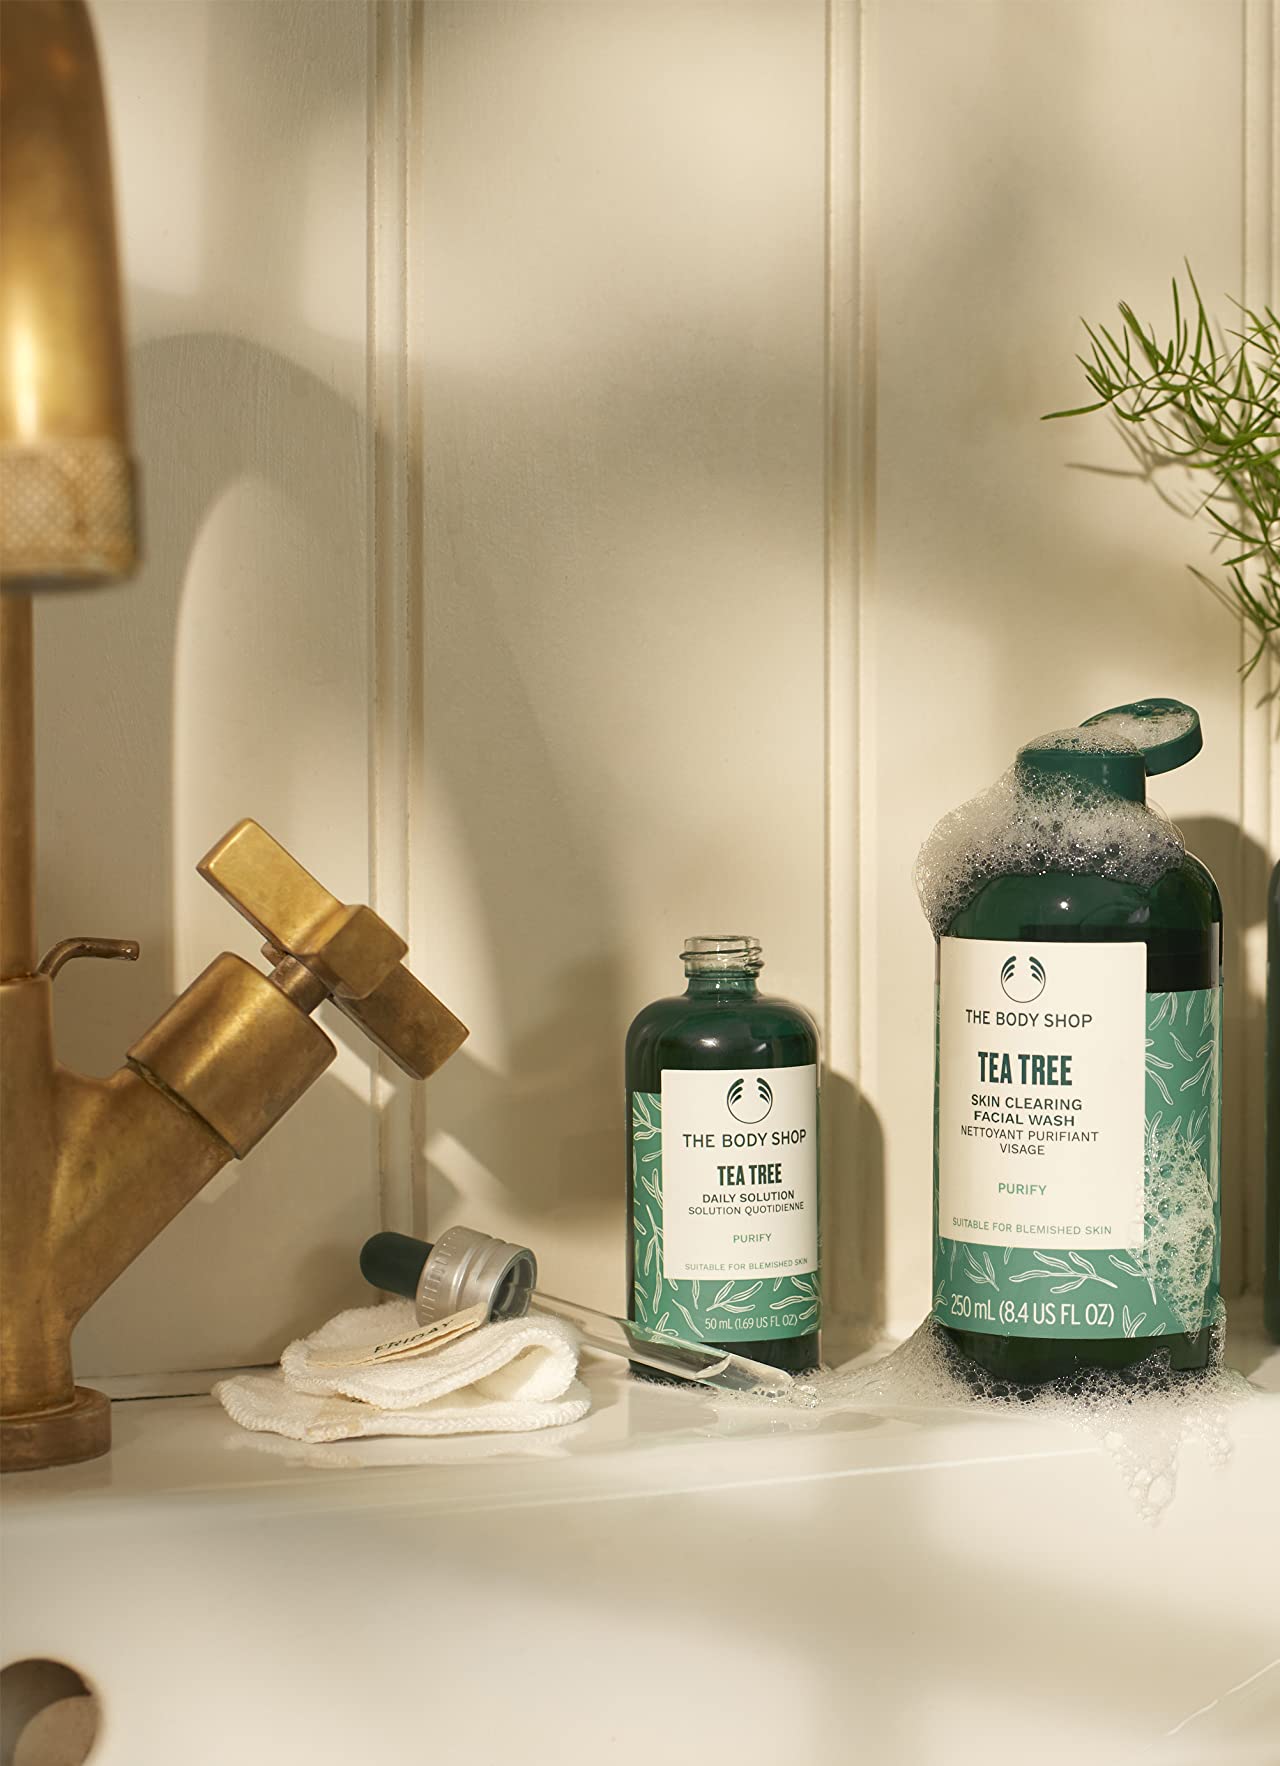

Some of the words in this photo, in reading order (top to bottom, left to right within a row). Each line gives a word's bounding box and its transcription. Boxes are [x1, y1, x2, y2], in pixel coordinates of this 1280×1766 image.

[966, 1010, 990, 1025] THE
[996, 1011, 1039, 1027] BODY
[1044, 1014, 1092, 1028] SHOP
[978, 1052, 1014, 1084] TEA
[1018, 1054, 1072, 1086] TREE
[971, 1094, 1000, 1108] SKIN
[1005, 1096, 1082, 1110] CLEARING
[974, 1111, 1023, 1124] FACIAL
[1028, 1114, 1075, 1126] WASH
[683, 1134, 715, 1148] THE
[722, 1132, 767, 1148] BODY
[772, 1129, 807, 1145] SHOP
[961, 1126, 1023, 1140] NETTOYANT
[1028, 1130, 1099, 1142] PURIFIANT
[1000, 1143, 1045, 1155] VISAGE
[717, 1165, 744, 1186] TEA
[749, 1163, 782, 1185] TREE
[702, 1193, 736, 1203] DAILY
[740, 1190, 794, 1202] SOLUTION
[998, 1183, 1047, 1196] PURIFY
[688, 1206, 740, 1215] SOLUTION
[744, 1201, 804, 1216] QUOTIDIENNE
[953, 1218, 989, 1231] SUITABLE
[992, 1222, 1013, 1232] FOR
[1016, 1224, 1082, 1235] BLEMISHED
[1085, 1226, 1112, 1235] SKIN
[733, 1233, 772, 1243] PURIFY
[749, 1259, 792, 1269] BLEMISHED
[794, 1257, 808, 1266] SKIN
[951, 1294, 972, 1317] 250
[975, 1298, 995, 1320] mL
[1000, 1302, 1028, 1323] (8.4
[1033, 1303, 1056, 1324] US
[1061, 1303, 1080, 1325] FL
[1086, 1302, 1115, 1326] OZ)
[705, 1318, 716, 1330] 50
[719, 1318, 733, 1330] mL
[735, 1317, 754, 1330] (1.69
[756, 1316, 767, 1328] US
[770, 1316, 782, 1326] FL
[784, 1314, 797, 1327] OZ)
